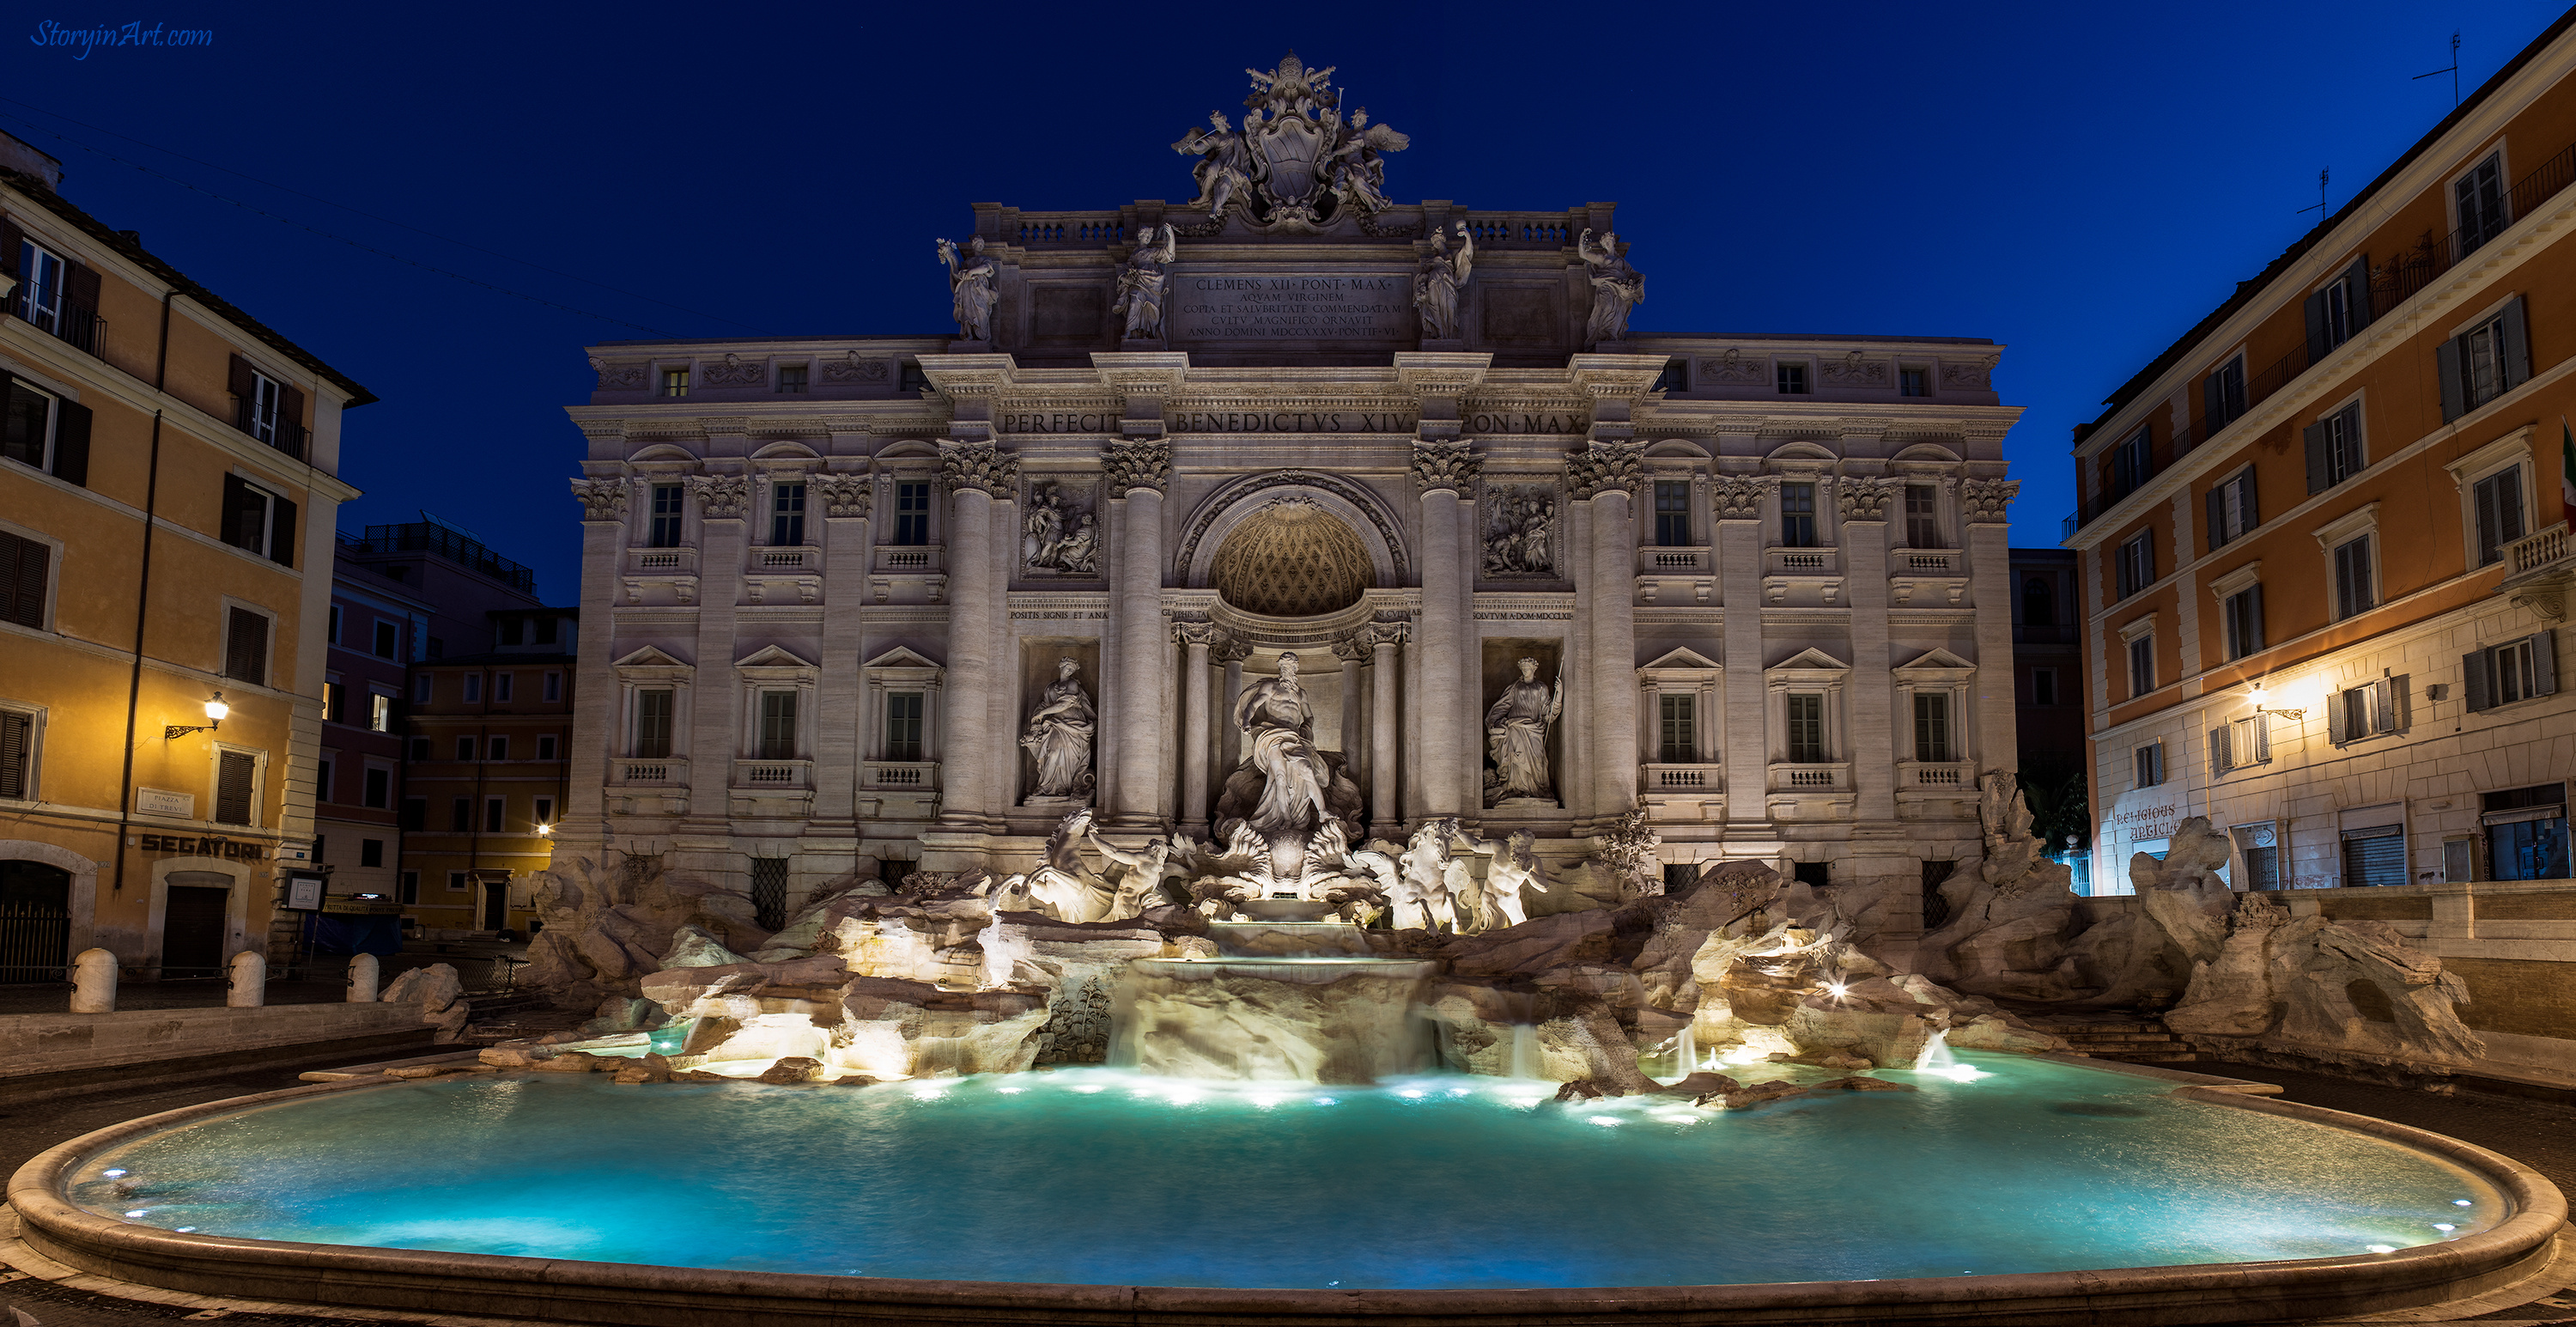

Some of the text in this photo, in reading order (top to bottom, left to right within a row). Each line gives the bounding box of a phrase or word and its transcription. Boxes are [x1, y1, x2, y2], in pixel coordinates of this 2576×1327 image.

[1196, 280, 1261, 290] CLEMENS
[1240, 293, 1280, 303] AQVAM
[1184, 305, 1216, 313] COPIA
[1236, 305, 1307, 313] SALVBRITATE
[1003, 414, 1123, 433] PERFECIT
[1176, 414, 1340, 432] BENEDICTVS
[155, 795, 179, 804] PIAZZA
[142, 834, 263, 859] SEGATORI
